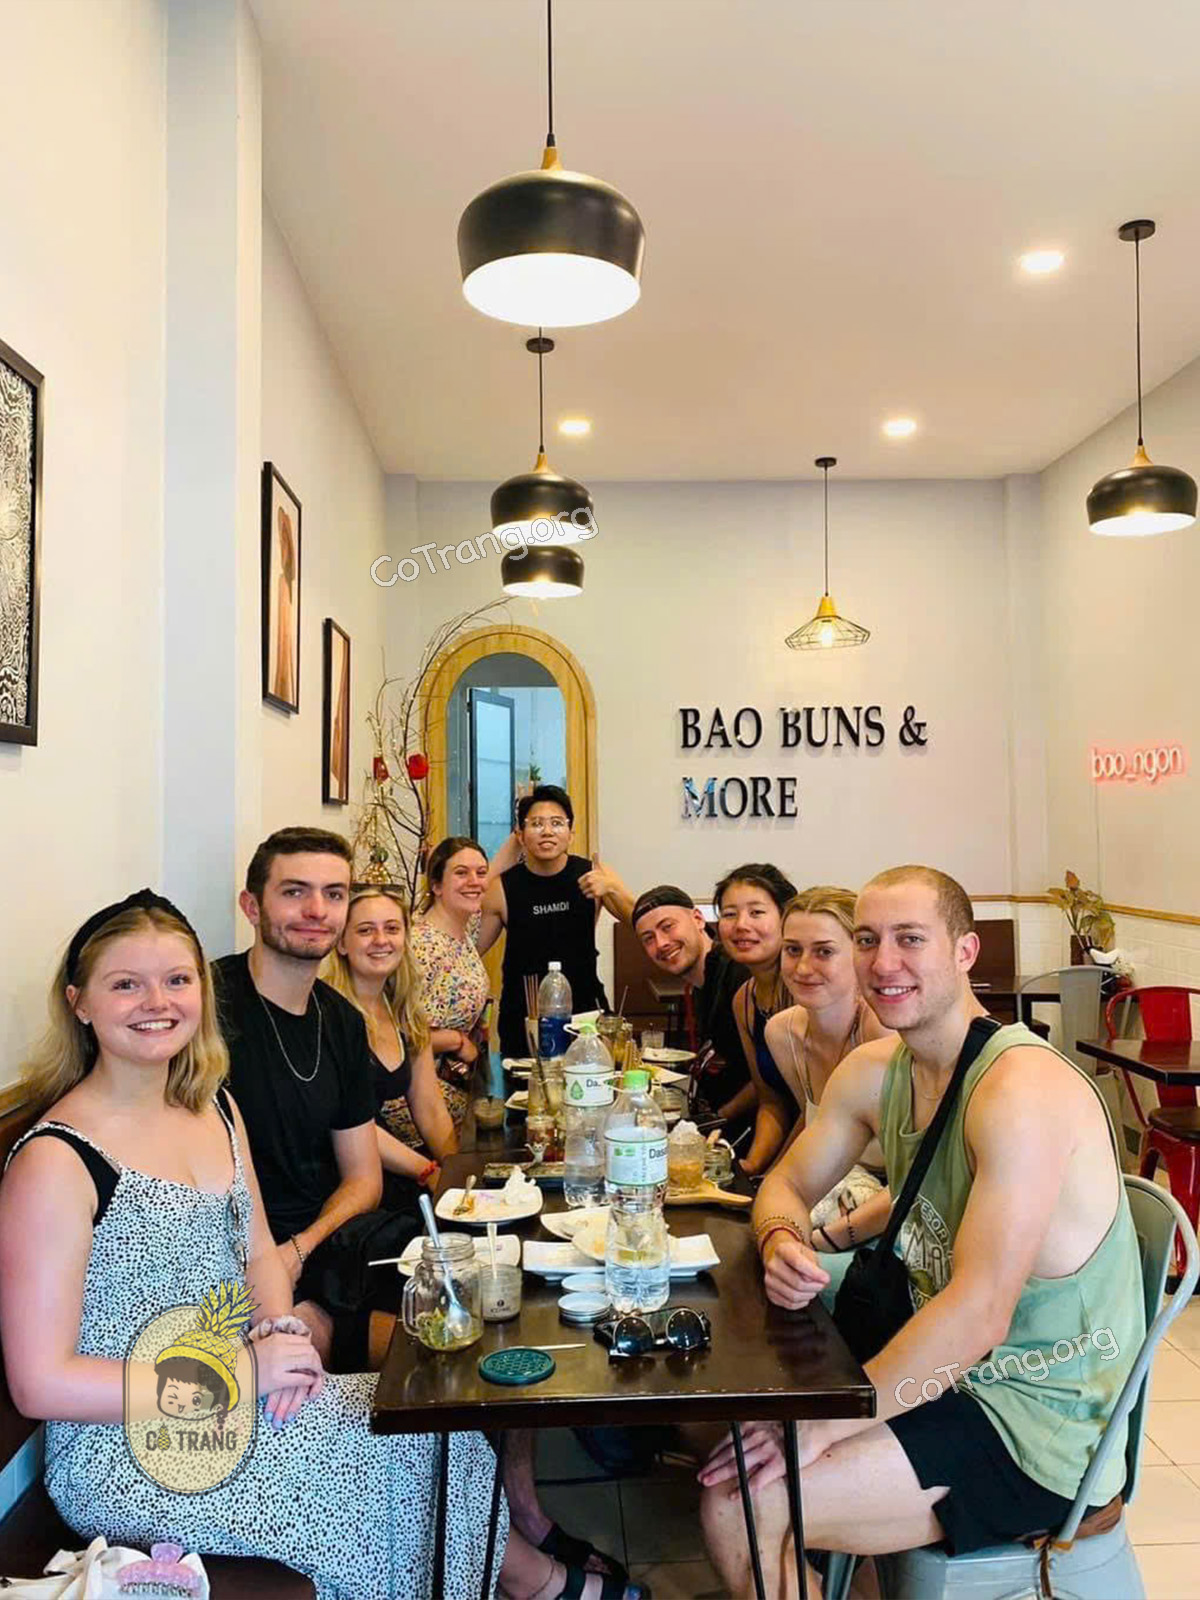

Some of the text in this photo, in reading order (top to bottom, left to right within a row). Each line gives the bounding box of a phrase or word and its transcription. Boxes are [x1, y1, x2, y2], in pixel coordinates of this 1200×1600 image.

[679, 705, 928, 748] BAO BUNS &
[681, 776, 798, 818] MORE
